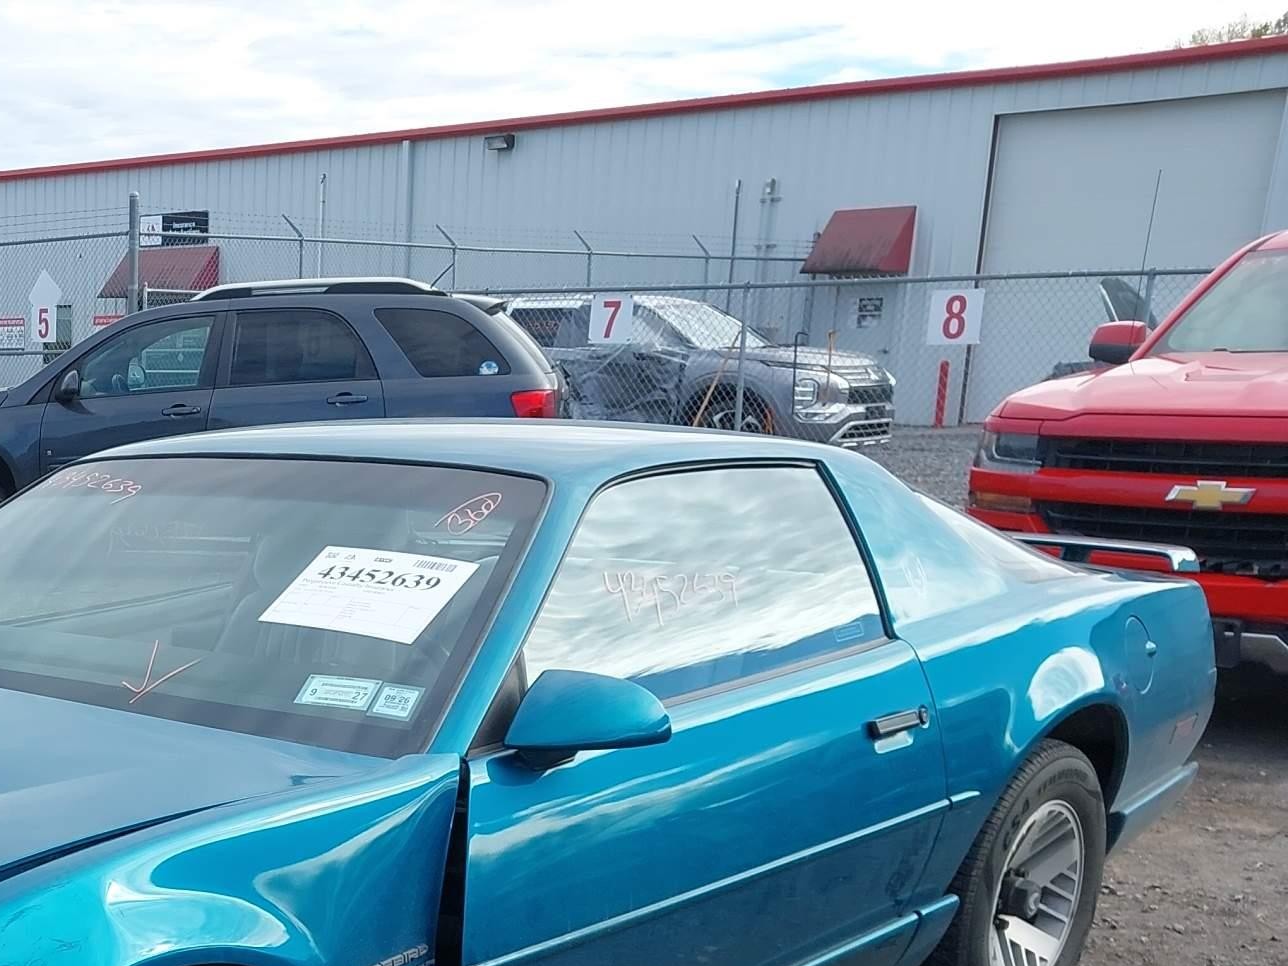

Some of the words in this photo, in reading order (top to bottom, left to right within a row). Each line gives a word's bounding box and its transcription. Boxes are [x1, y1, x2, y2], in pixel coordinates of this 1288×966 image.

[38, 308, 50, 339] 5
[603, 301, 622, 338] 7
[942, 295, 967, 339] 8
[317, 565, 441, 590] 43452639
[309, 688, 318, 696] 9
[352, 691, 368, 701] 27
